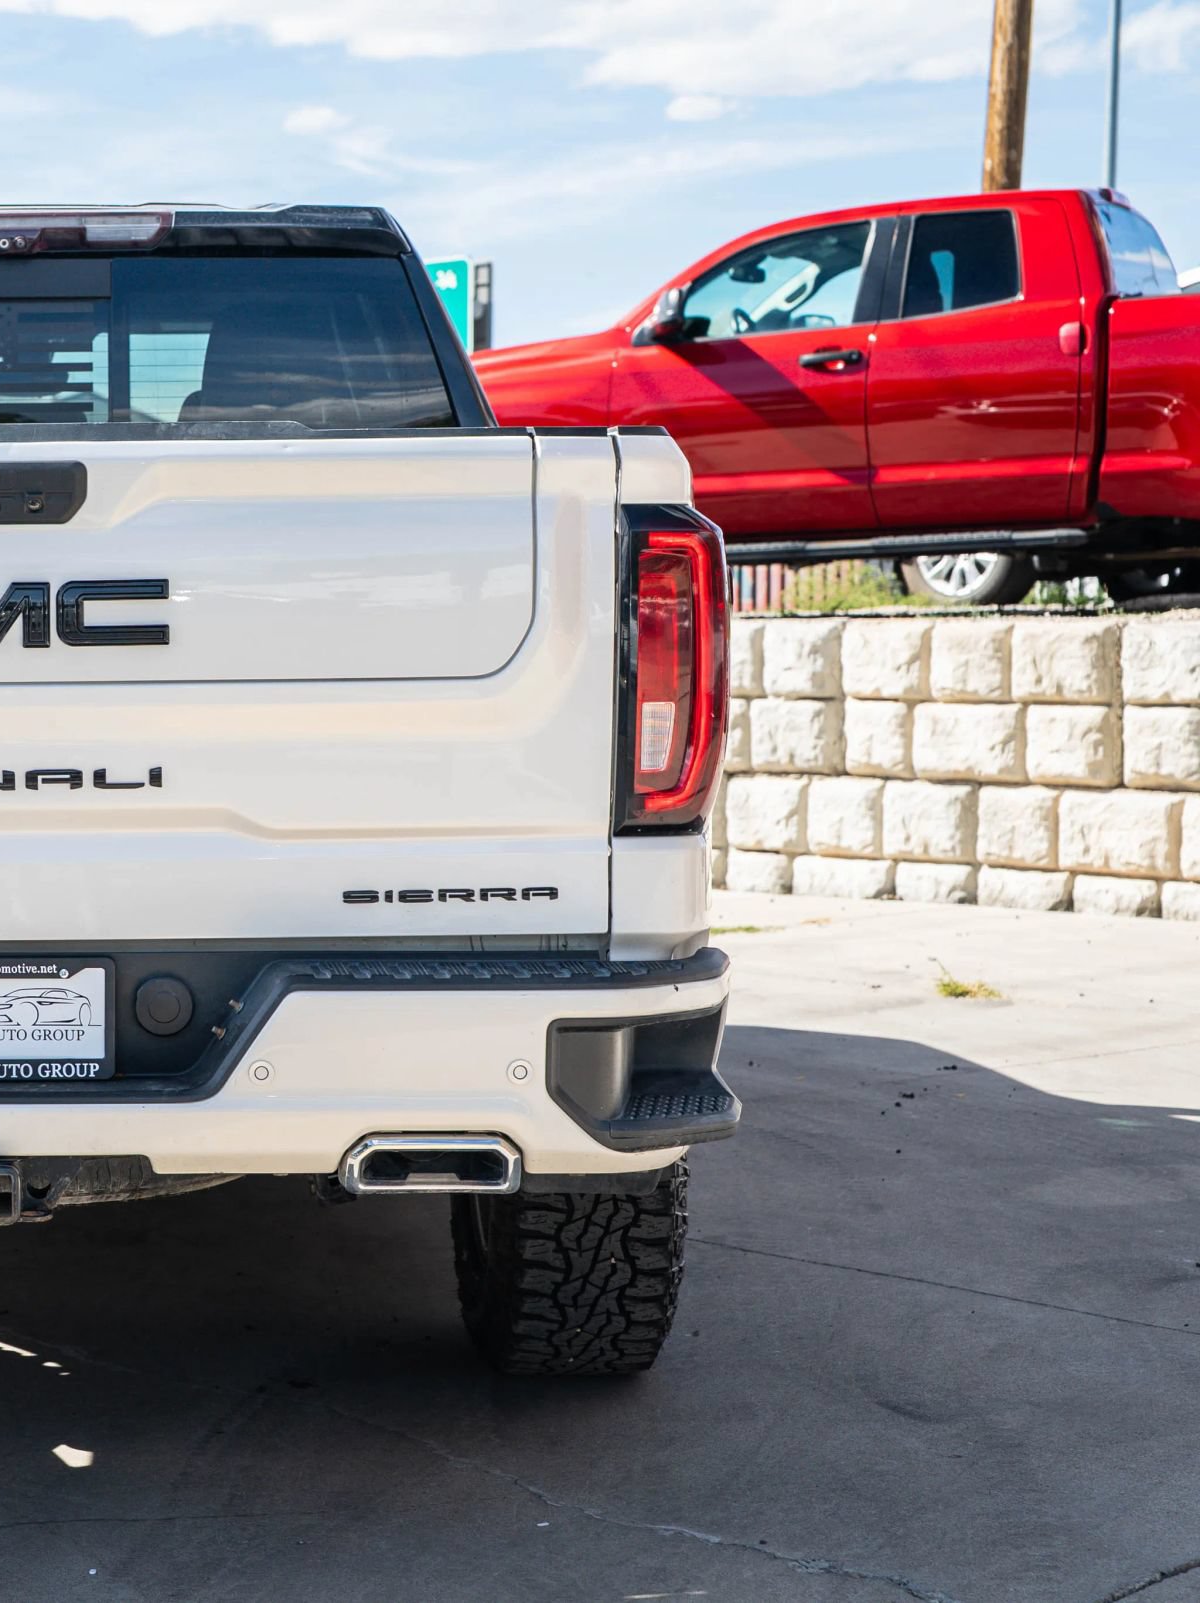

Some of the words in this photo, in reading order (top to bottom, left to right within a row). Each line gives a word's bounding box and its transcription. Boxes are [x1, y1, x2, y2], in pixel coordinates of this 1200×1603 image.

[342, 886, 559, 904] SIERRA
[31, 1028, 86, 1041] GROUP
[37, 1062, 101, 1078] GROUP
